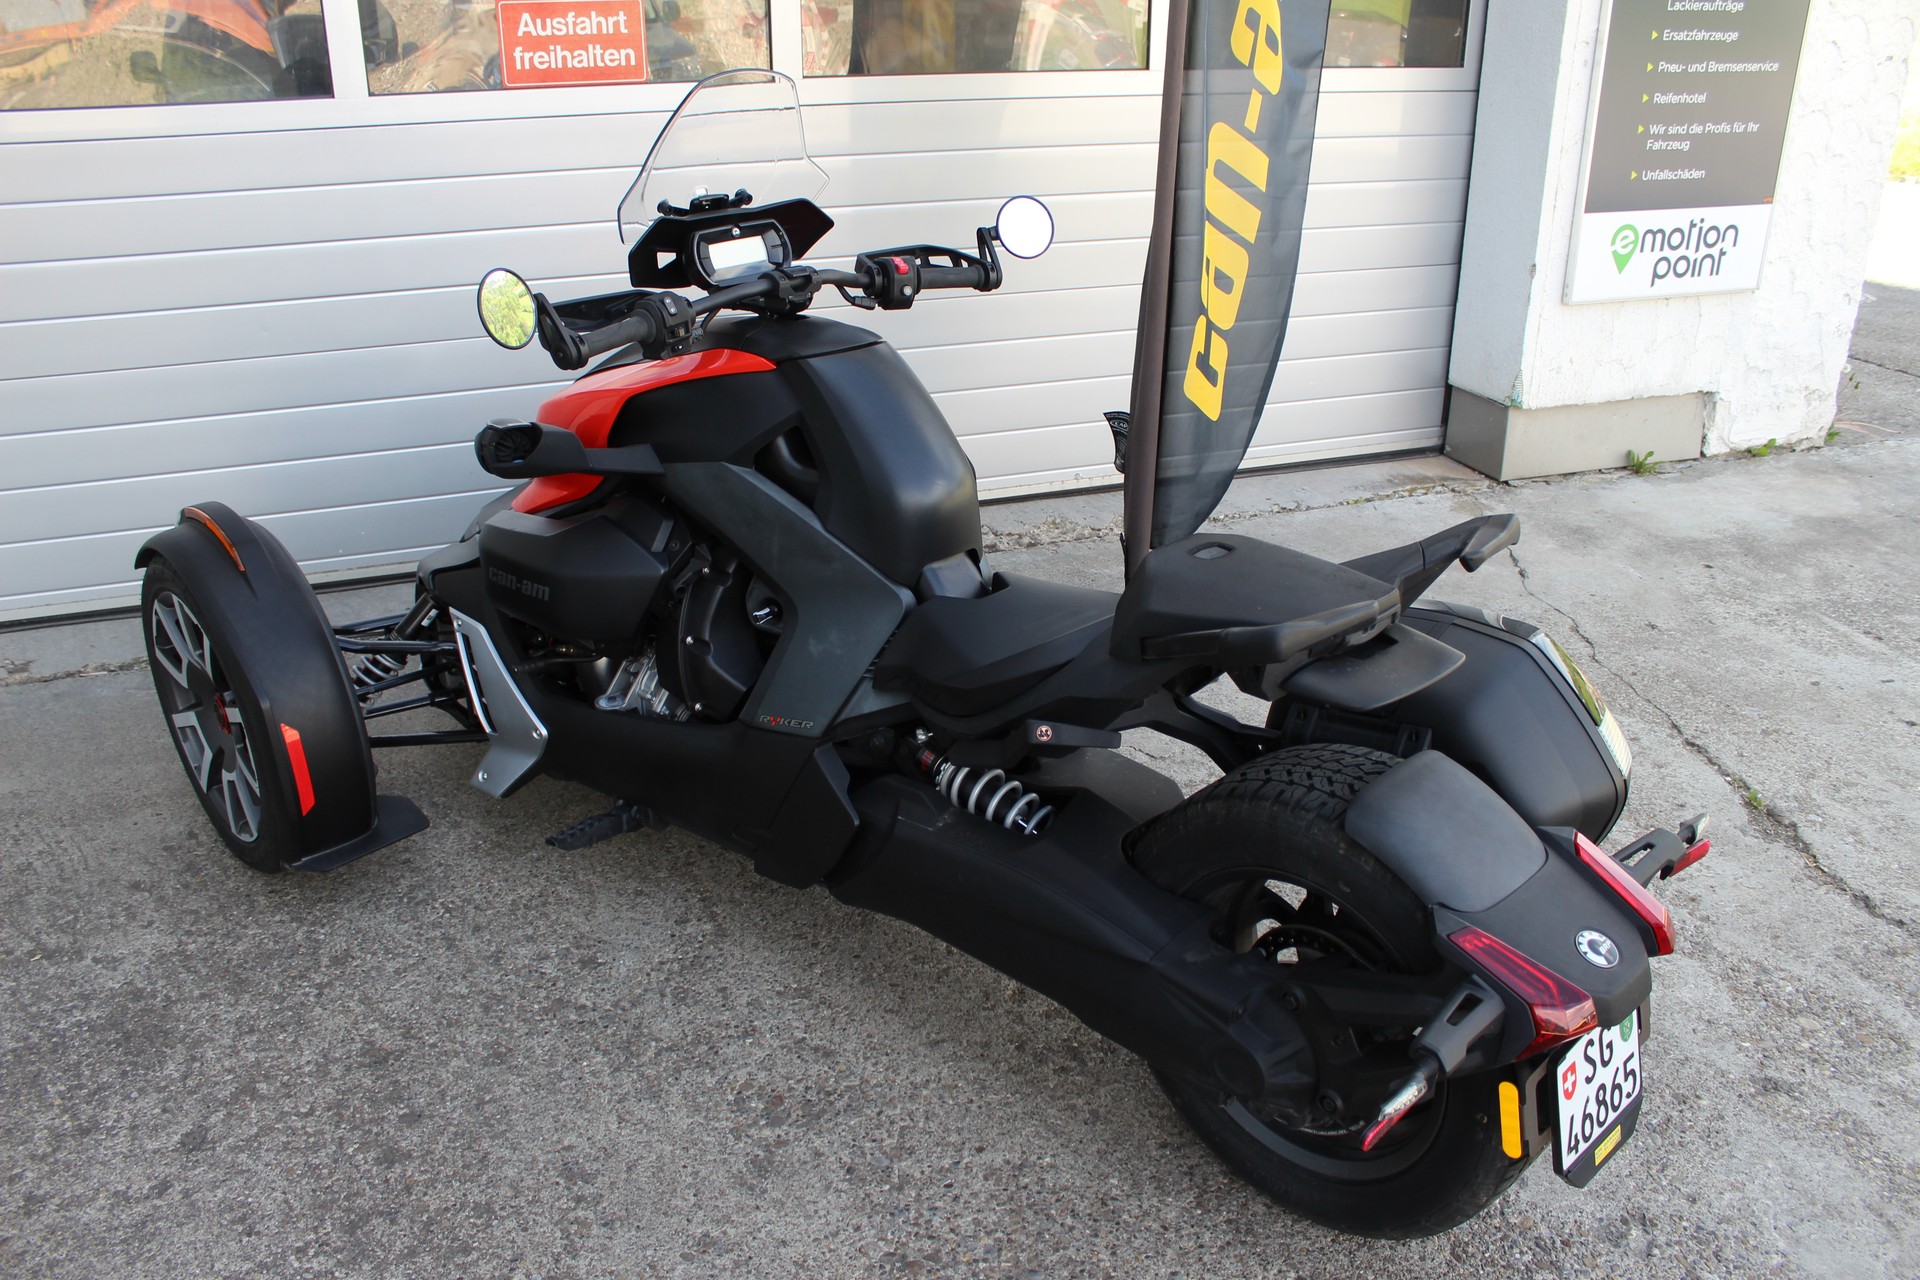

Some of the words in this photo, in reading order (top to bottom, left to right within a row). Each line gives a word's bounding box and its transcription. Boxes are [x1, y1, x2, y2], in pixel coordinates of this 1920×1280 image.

[1667, 0, 1744, 13] Lackieraufträge
[517, 11, 628, 37] Ausfahrt
[1663, 29, 1739, 42] Ersatzfahrzeuge
[513, 44, 636, 70] freihalten
[1658, 61, 1686, 73] Pneu-
[1688, 61, 1706, 72] und
[1708, 60, 1779, 73] Bremsenservice
[1653, 92, 1706, 104] Reifenhotel
[1649, 124, 1666, 135] Wir
[1668, 123, 1687, 135] sind
[1689, 123, 1703, 134] die
[1705, 121, 1731, 134] Profis
[1732, 122, 1746, 133] für
[1747, 121, 1760, 132] Ihr
[1646, 139, 1690, 151] Fahrzeug
[1642, 168, 1706, 181] Unfallschäden
[1650, 247, 1727, 288] point
[488, 566, 550, 602] can-am
[760, 715, 815, 729] RYKER
[1583, 1026, 1614, 1085] SG
[1567, 1051, 1637, 1157] 46865
